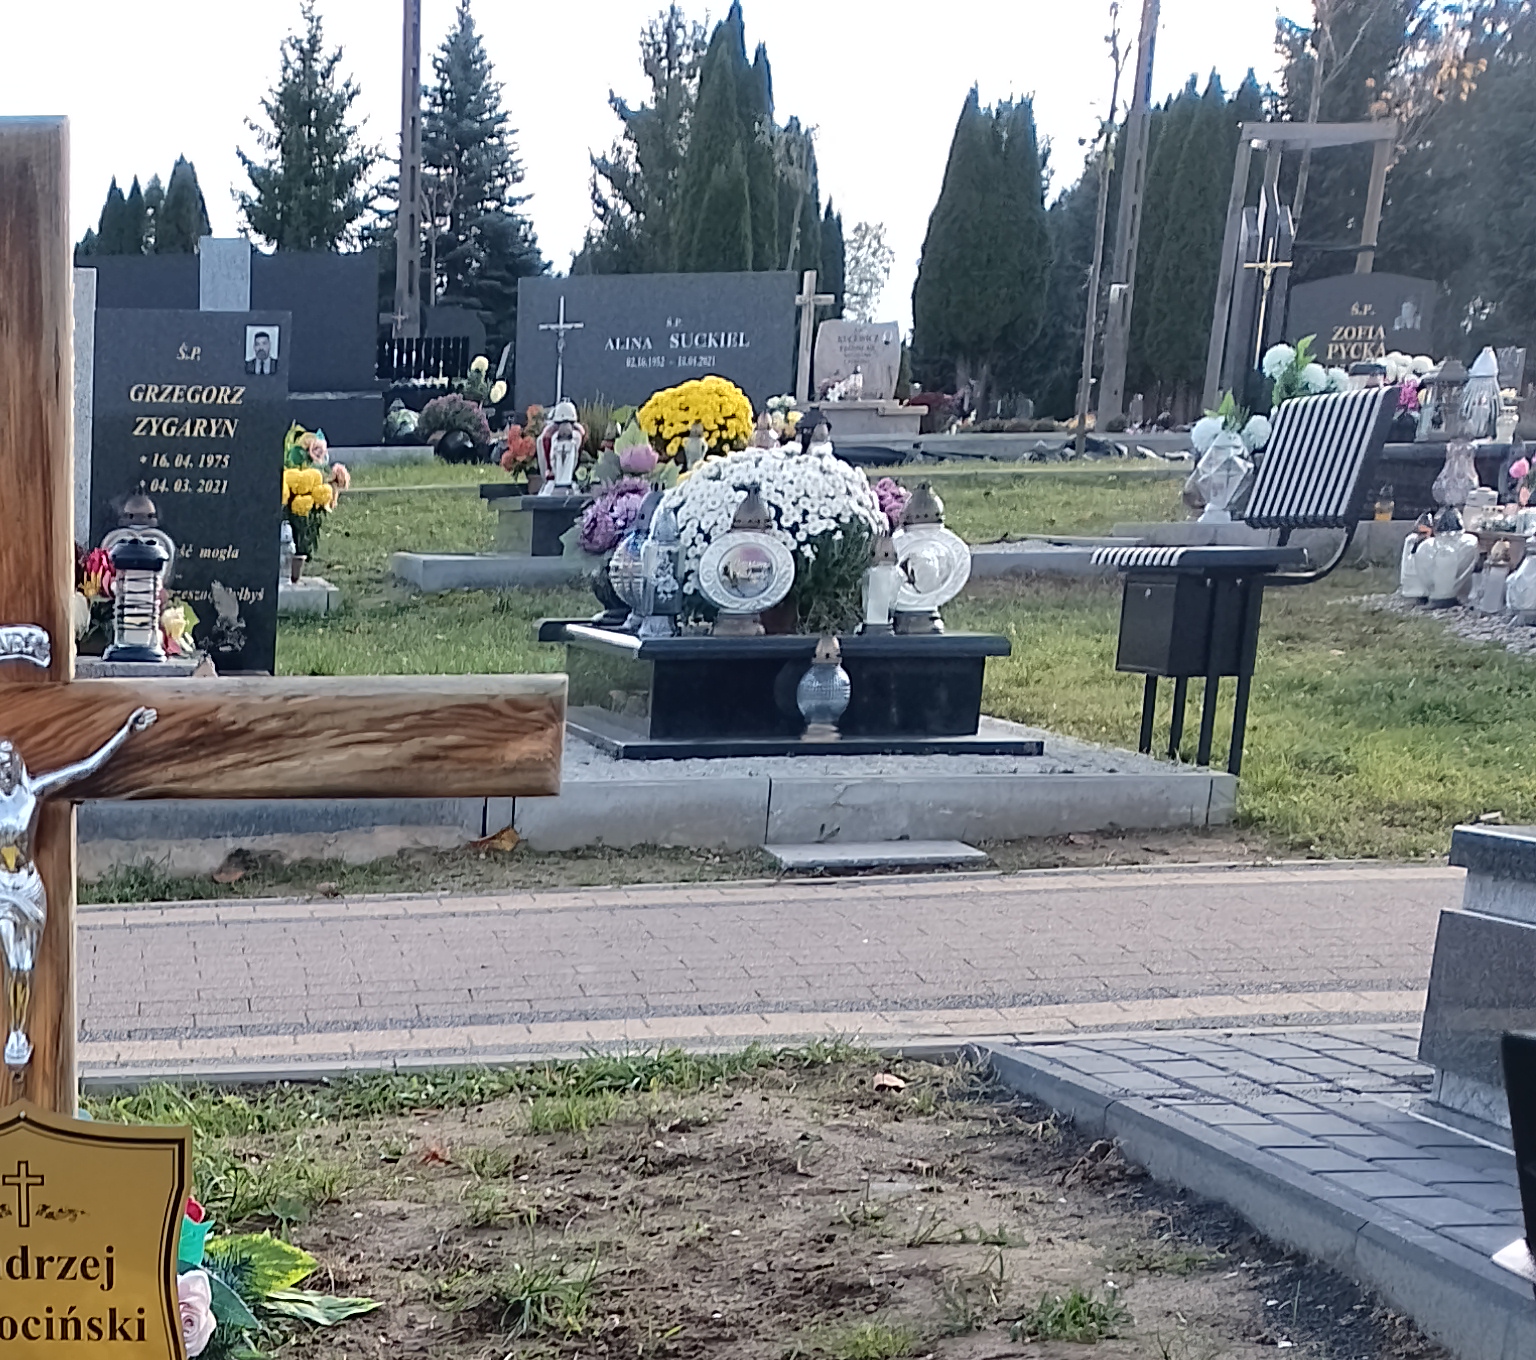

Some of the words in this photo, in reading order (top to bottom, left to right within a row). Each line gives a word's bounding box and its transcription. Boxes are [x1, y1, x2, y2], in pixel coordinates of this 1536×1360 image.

[604, 336, 653, 350] ALINA
[669, 332, 750, 349] SUCKIEL
[1331, 325, 1386, 341] ZOFIA
[1327, 342, 1386, 361] PYCKA
[129, 383, 246, 405] GRZEGORZ
[132, 416, 239, 438] ZYGARYN
[198, 453, 231, 469] 1975
